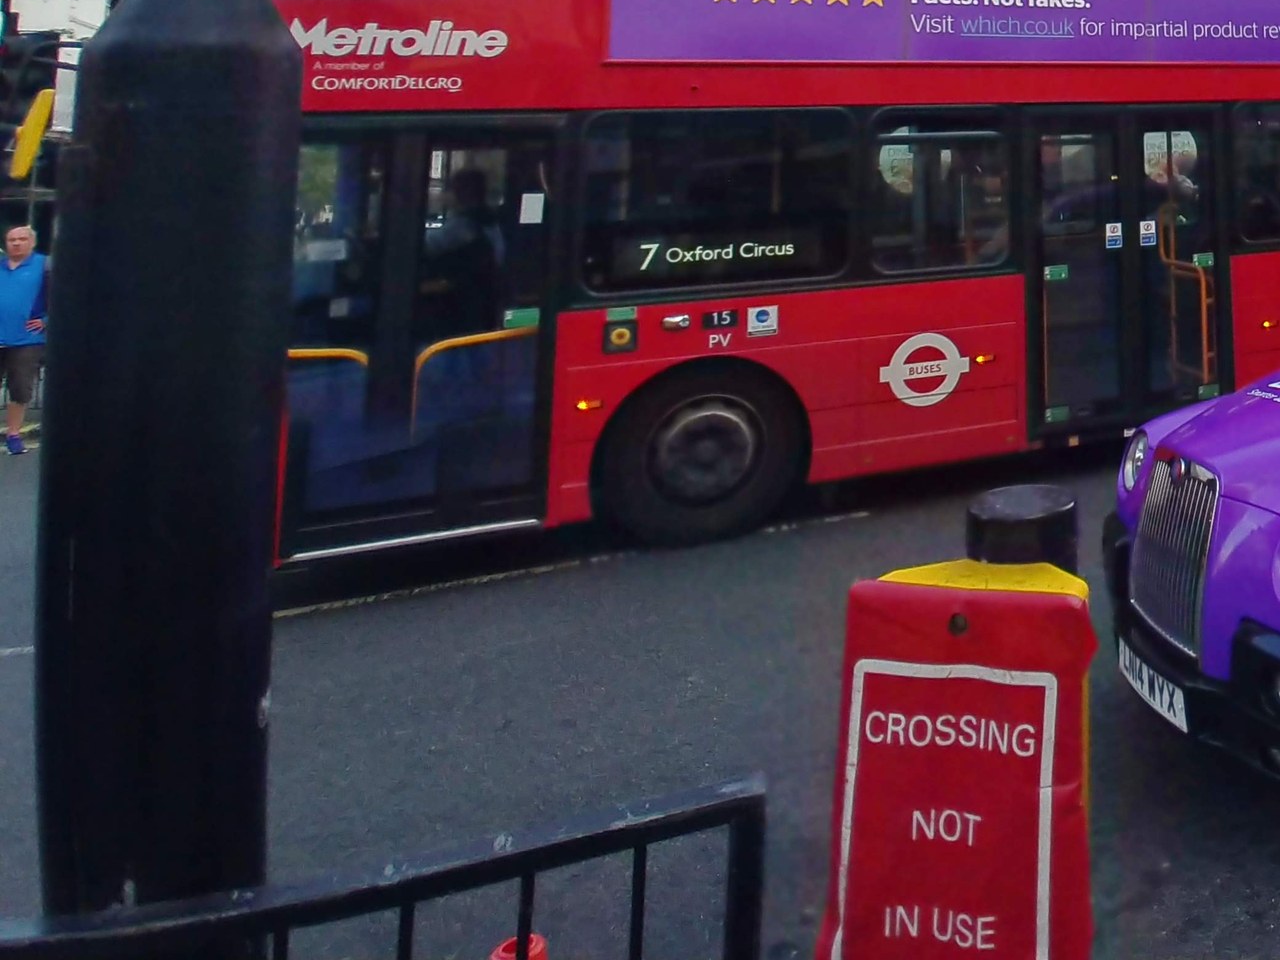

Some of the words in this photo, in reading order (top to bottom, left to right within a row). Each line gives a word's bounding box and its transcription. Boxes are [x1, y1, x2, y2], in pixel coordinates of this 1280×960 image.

[290, 18, 508, 58] Metroline
[910, 14, 955, 33] Visit
[961, 16, 1075, 37] which.co.uk
[1080, 18, 1105, 36] for
[1111, 18, 1188, 40] impartial
[1193, 22, 1259, 41] product
[313, 61, 322, 70] A
[325, 61, 370, 71] member
[374, 60, 385, 70] of
[640, 243, 660, 271] 7
[666, 244, 734, 263] Oxford
[739, 242, 795, 258] Circus
[711, 310, 732, 326] 15
[708, 333, 732, 349] PV
[908, 364, 942, 376] BUSES
[1147, 666, 1177, 719] WYX
[865, 711, 1036, 757] CROSSING
[912, 808, 982, 847] NOT
[884, 905, 919, 937] IN
[933, 907, 996, 949] USE
